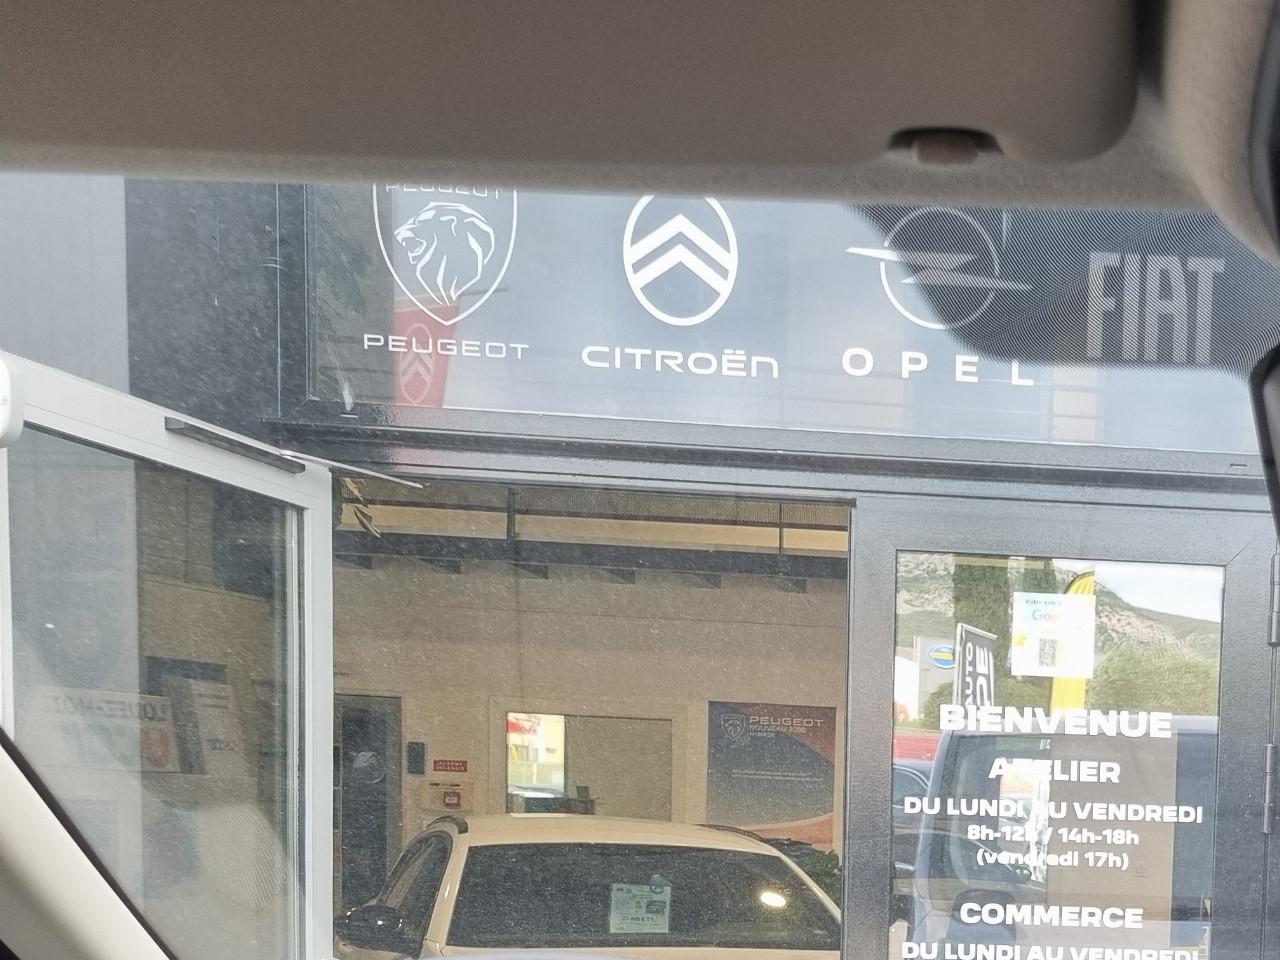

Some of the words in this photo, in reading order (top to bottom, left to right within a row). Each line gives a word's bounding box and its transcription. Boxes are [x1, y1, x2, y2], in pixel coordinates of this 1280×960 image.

[1087, 251, 1225, 363] FIAT
[363, 333, 530, 360] PEUGEOT
[842, 347, 1035, 386] OPEL
[749, 716, 824, 727] PEUGEOT
[939, 704, 1173, 738] BIENVENUE
[988, 757, 1121, 784] ATELIER
[904, 796, 941, 815] DU
[947, 798, 1023, 817] LUNDI
[1073, 802, 1203, 823] VENDREDI
[1057, 827, 1139, 845] 14h-18h
[976, 848, 1079, 867] (vendredi
[1084, 851, 1129, 870] 17h)
[960, 902, 1144, 929] COMMERCE
[902, 942, 938, 959] DU
